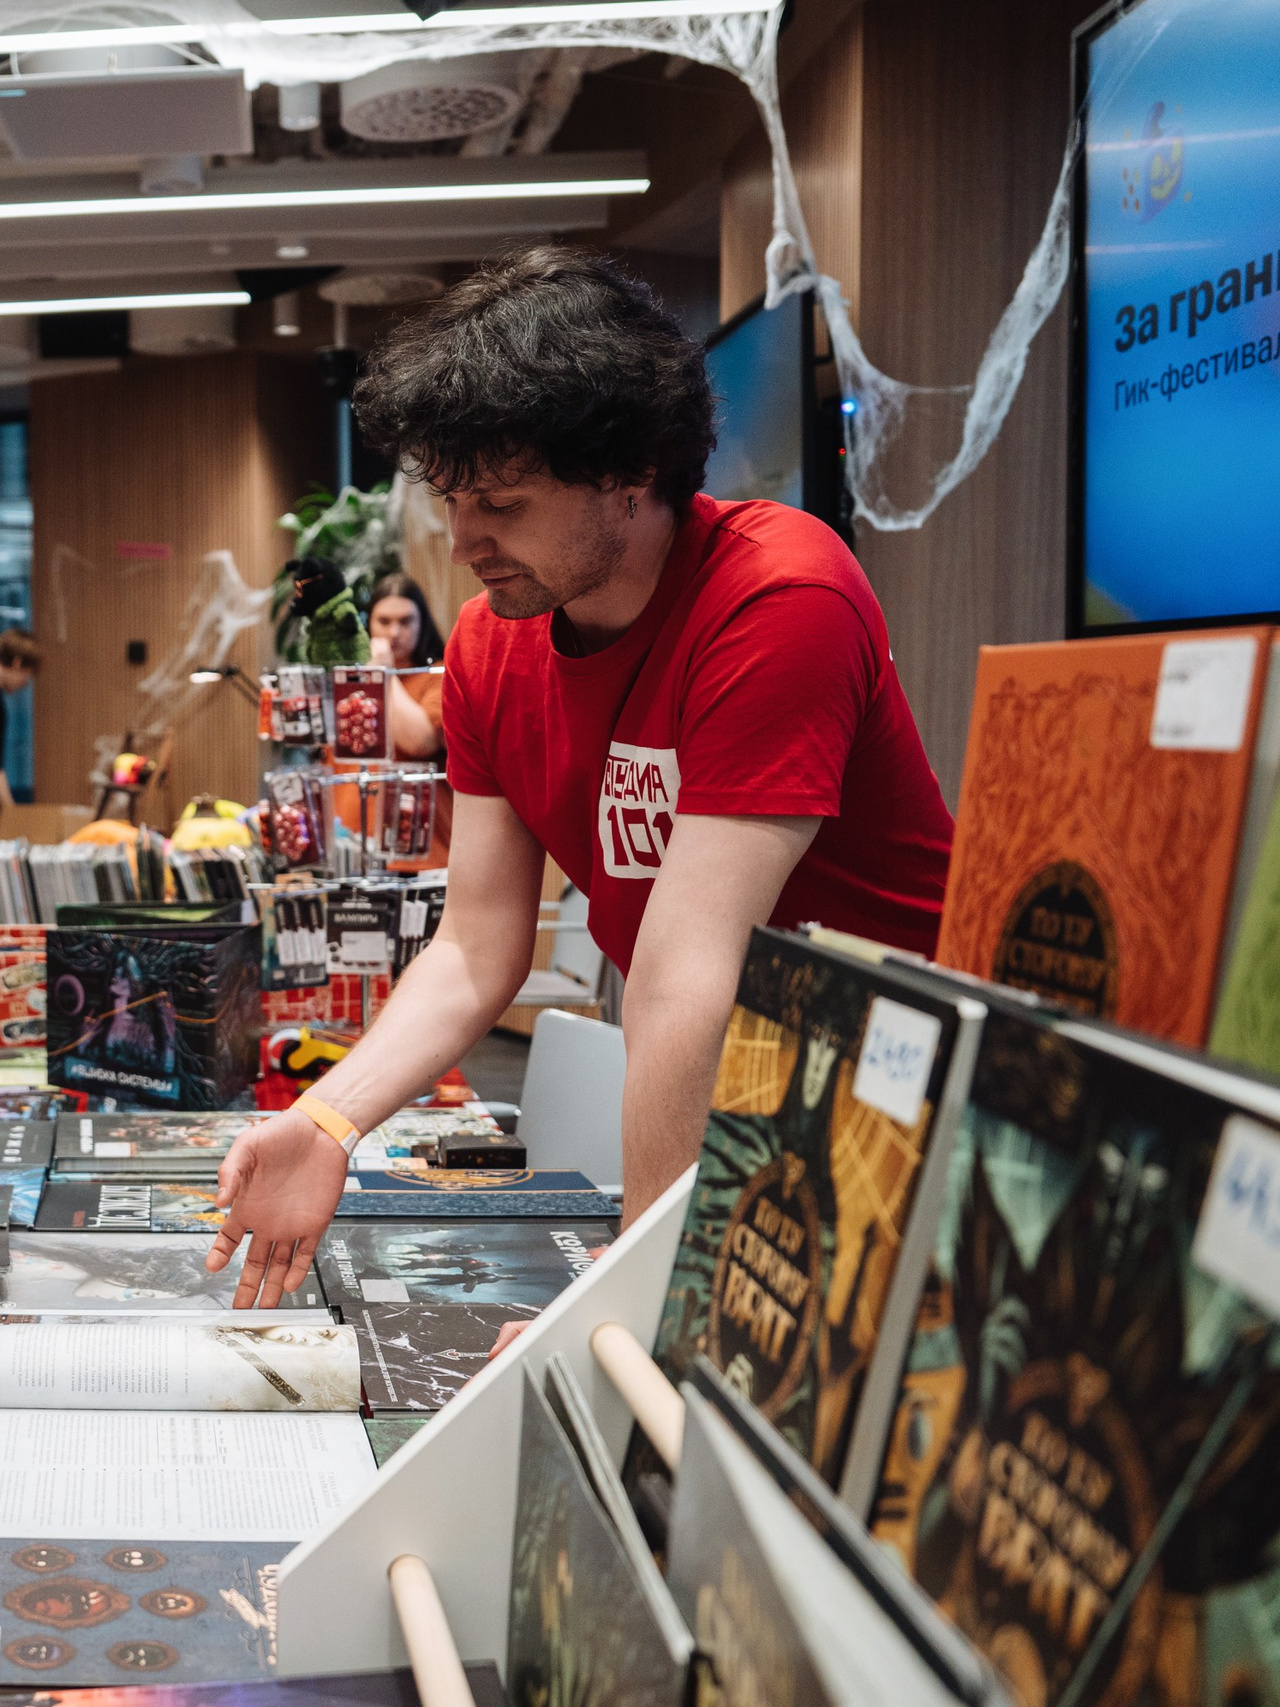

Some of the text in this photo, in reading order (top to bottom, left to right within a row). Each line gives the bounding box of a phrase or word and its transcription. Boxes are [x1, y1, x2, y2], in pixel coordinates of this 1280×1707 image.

[1114, 248, 1280, 353] За гран
[606, 804, 674, 868] 101
[87, 1185, 152, 1228] БЛЭКСЭД
[549, 1231, 596, 1276] КОРИО
